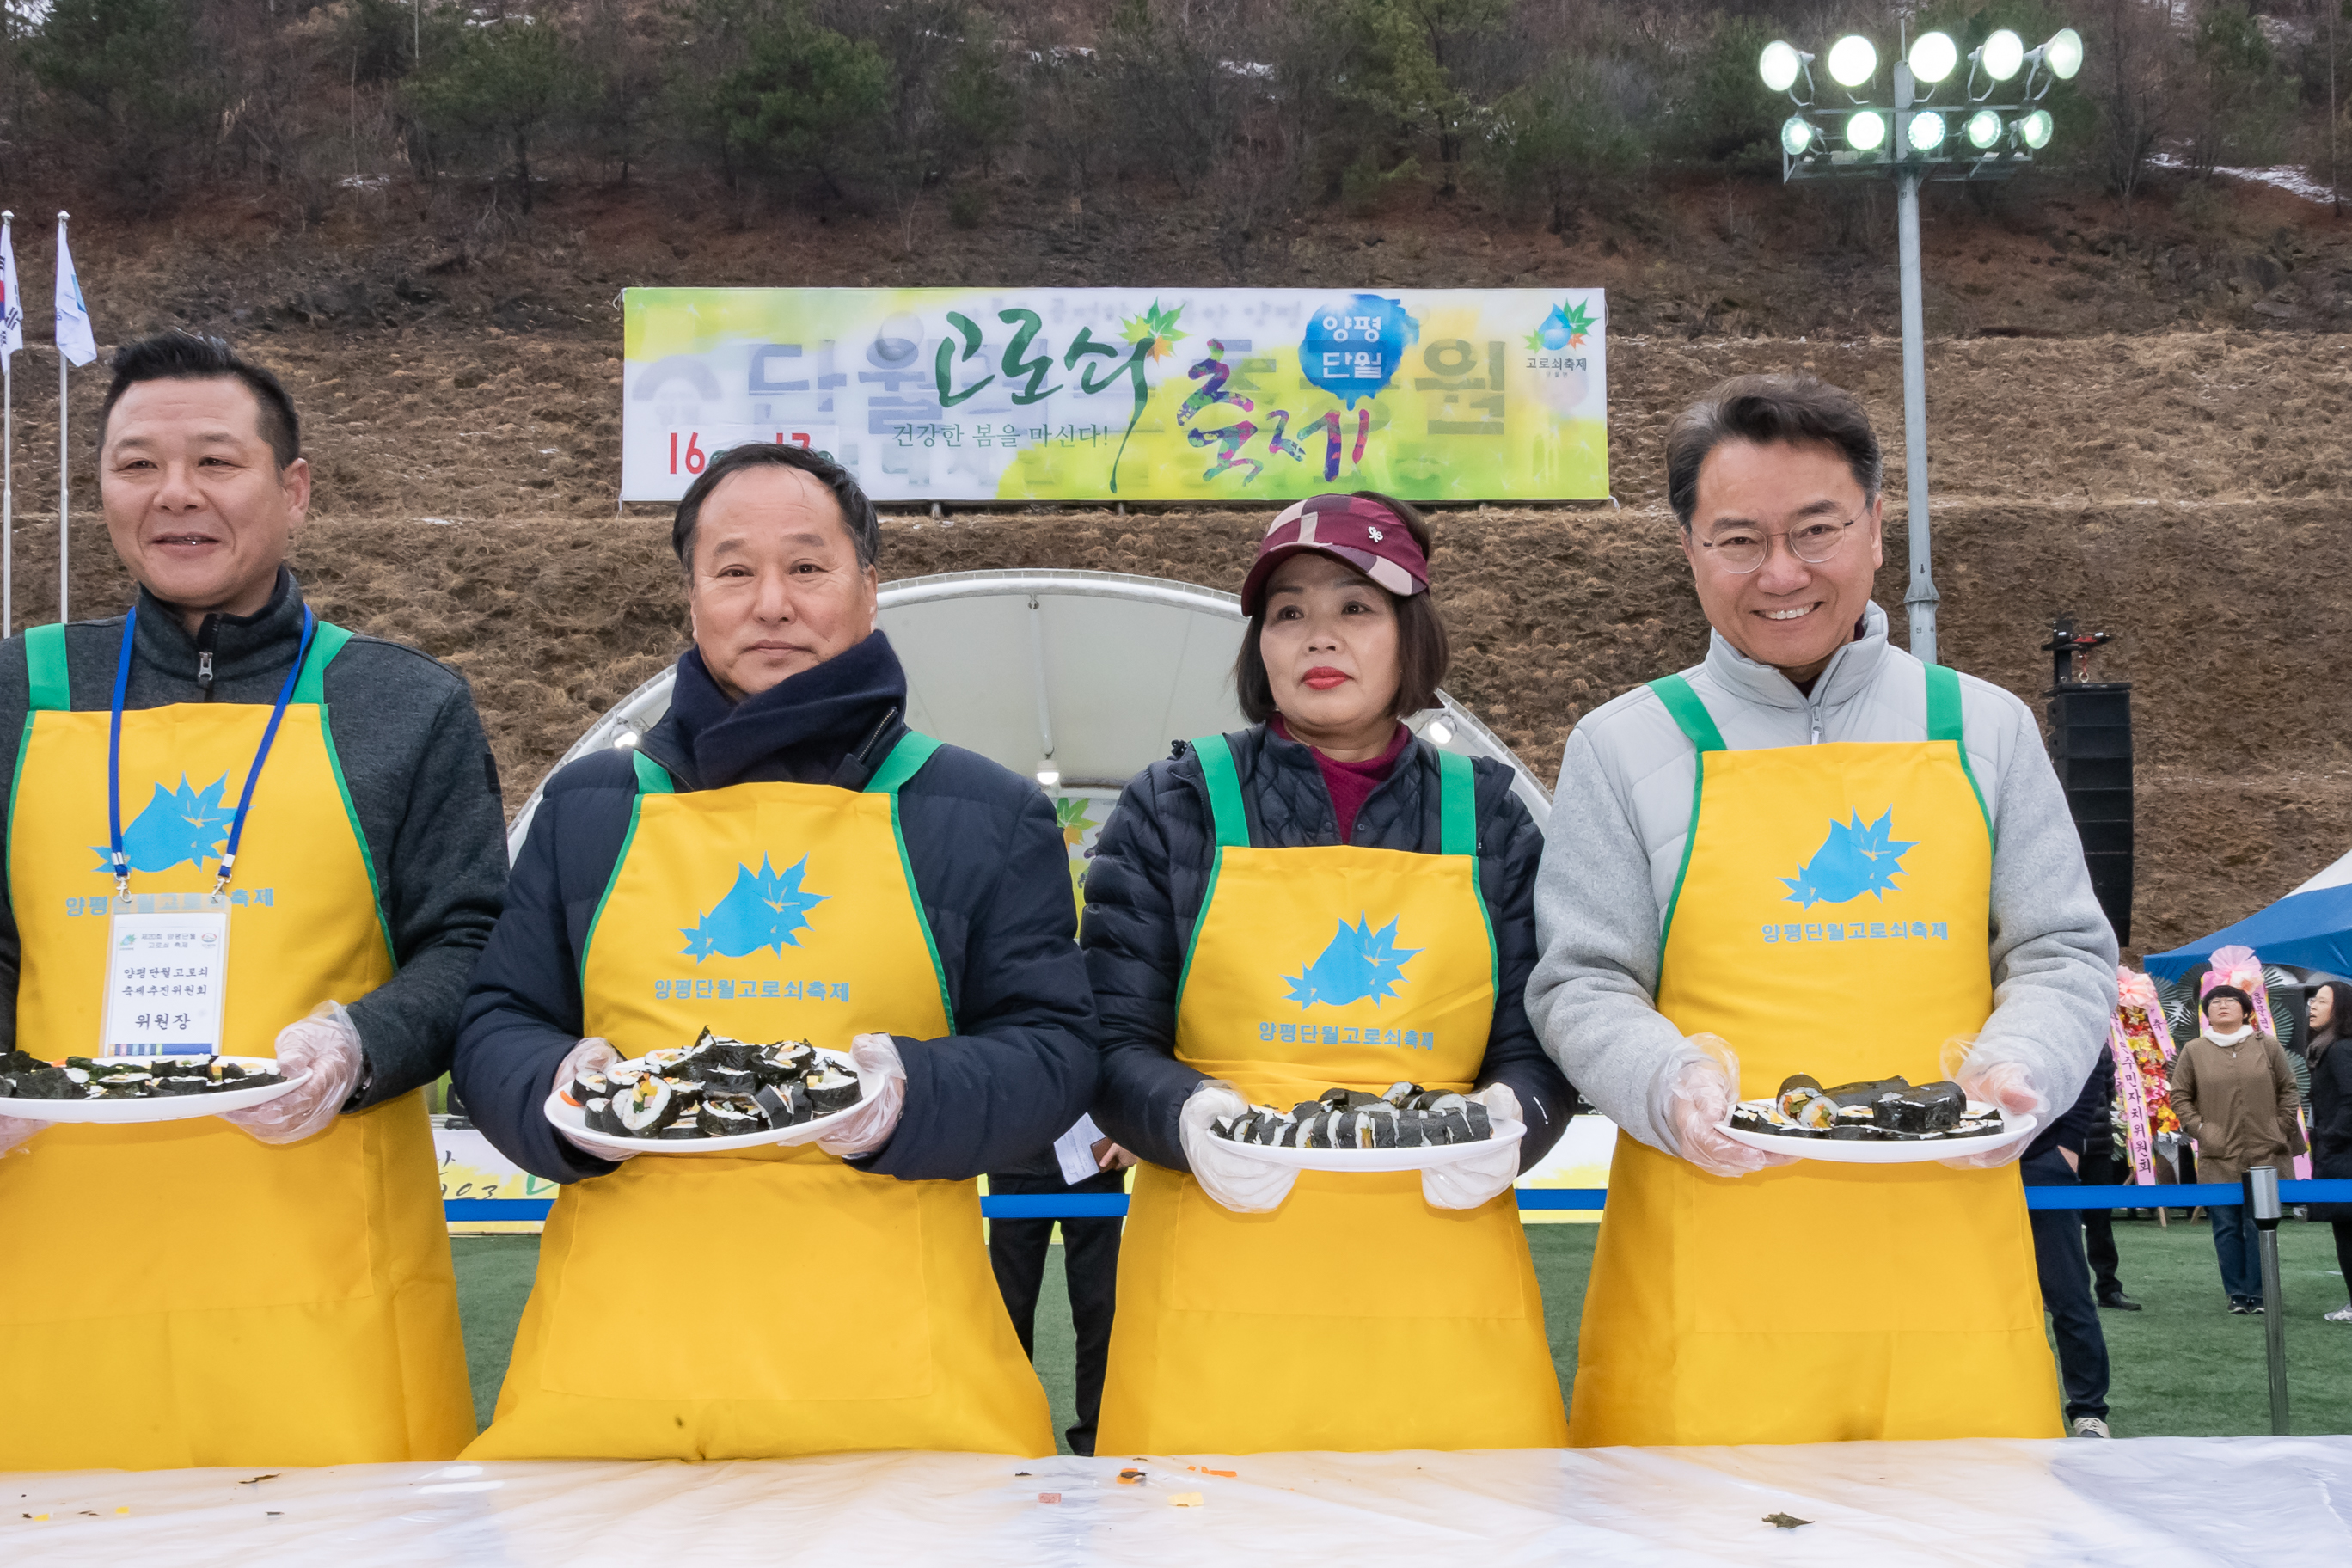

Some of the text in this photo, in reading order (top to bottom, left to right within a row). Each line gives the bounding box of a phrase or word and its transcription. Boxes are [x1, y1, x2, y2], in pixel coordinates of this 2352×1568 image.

[1322, 315, 1382, 341] 양평
[1322, 352, 1382, 379] 단월
[1526, 358, 1587, 371] 고로쇠축제
[935, 308, 1155, 493] 고로쇠
[1176, 338, 1370, 487] 축제
[892, 423, 1107, 447] 건강한 봄을 마신다!
[1761, 921, 1948, 943] 양평단월고로쇠축제
[654, 978, 850, 1002] 양평단월고로쇠축제
[135, 1013, 191, 1030] 위원장
[1259, 1021, 1434, 1050] 양평단월고로쇠축제
